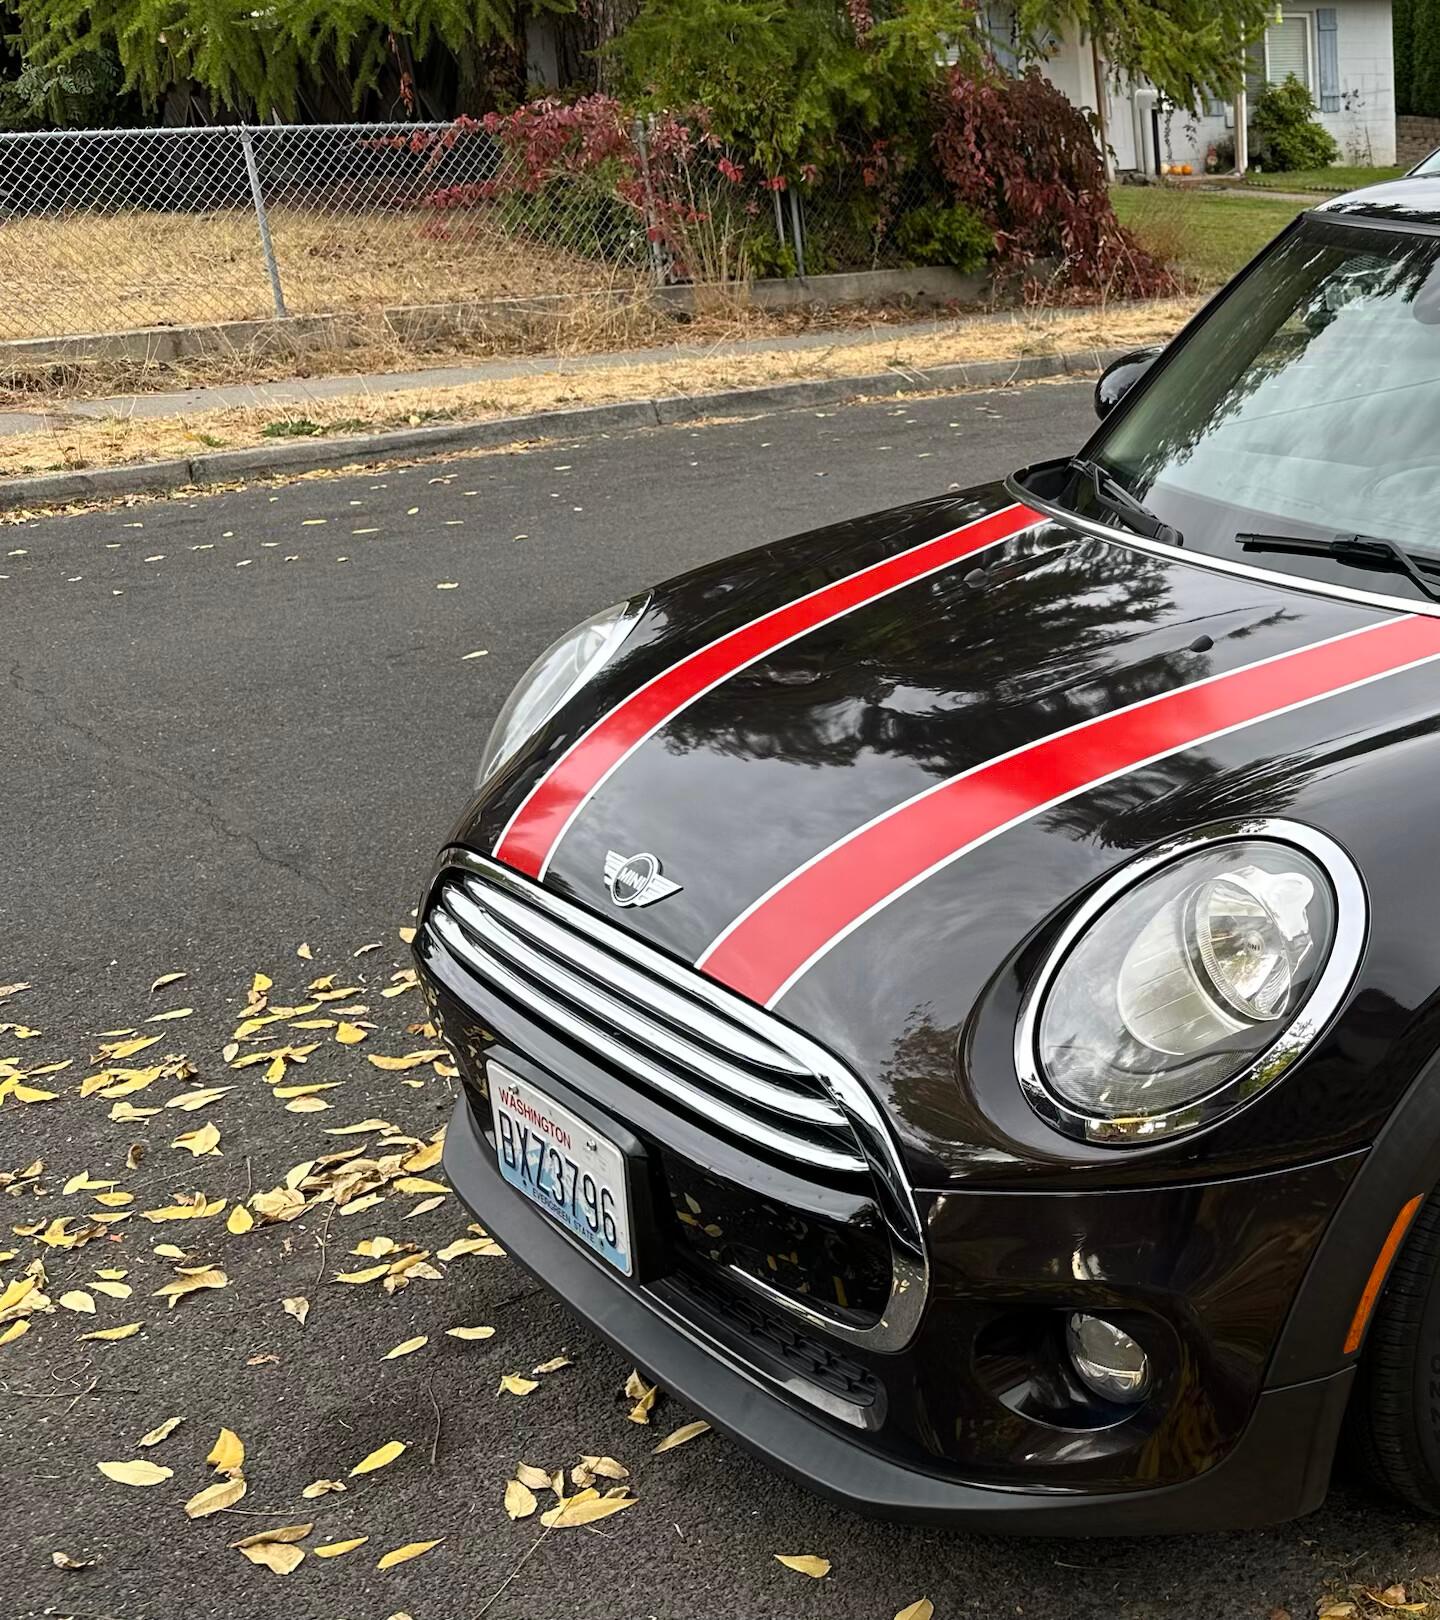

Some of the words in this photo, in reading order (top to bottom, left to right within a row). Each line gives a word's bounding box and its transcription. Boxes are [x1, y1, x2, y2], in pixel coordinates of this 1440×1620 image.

[499, 1087, 571, 1150] WASHINGTON
[498, 1109, 617, 1248] BXZ3796
[532, 1187, 571, 1225] EVERGREEN
[573, 1216, 595, 1243] STATE
